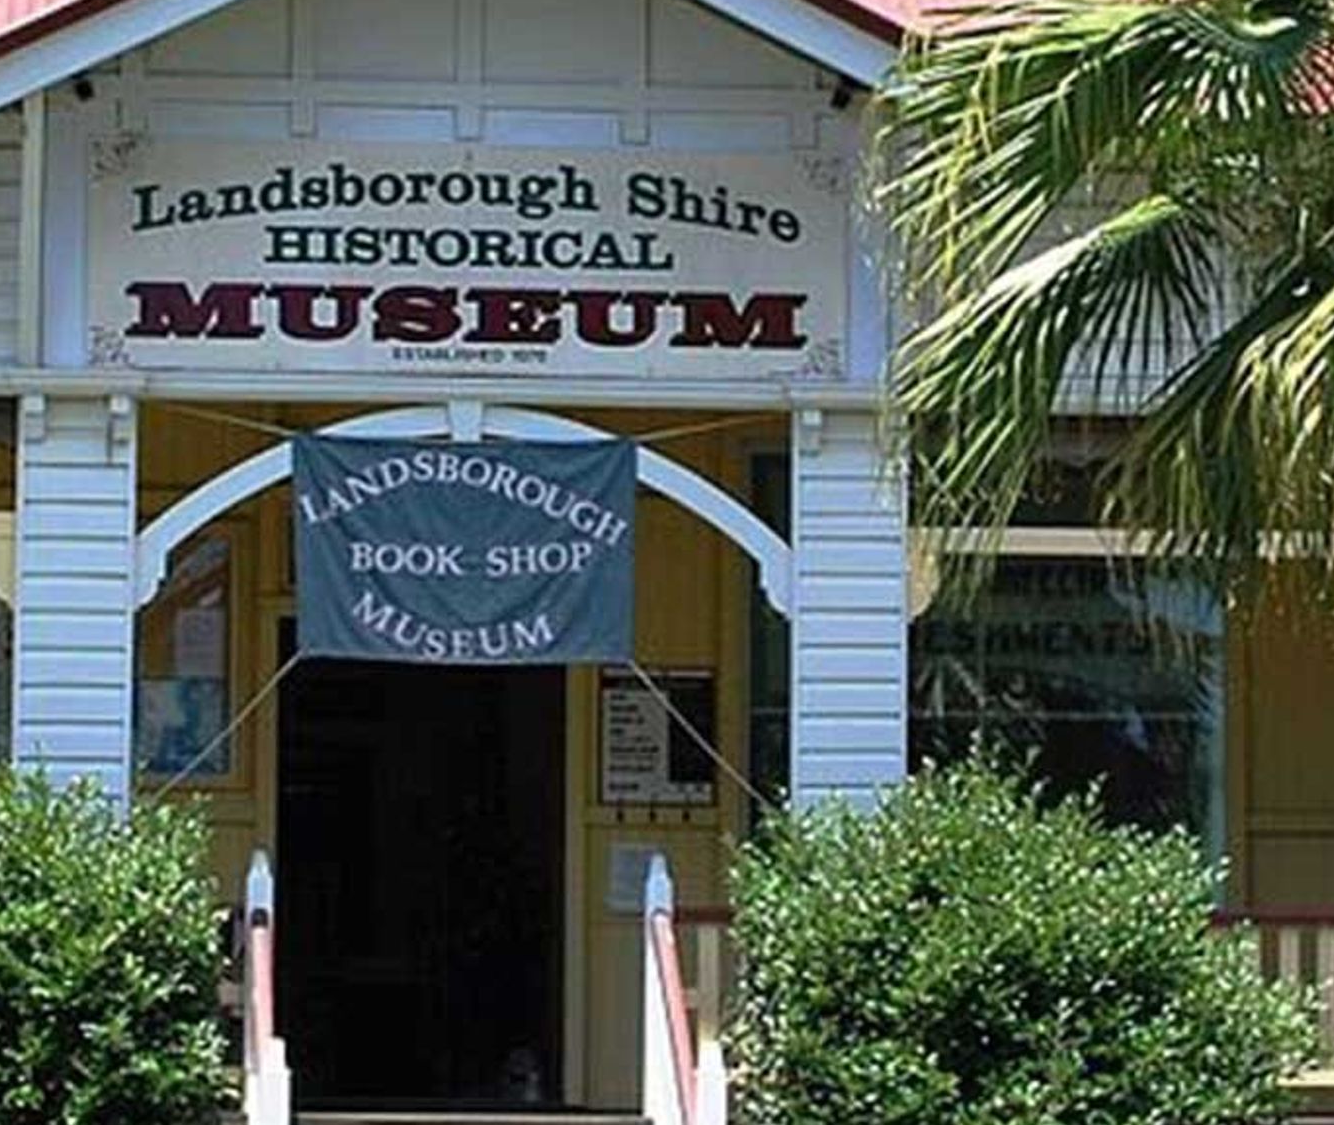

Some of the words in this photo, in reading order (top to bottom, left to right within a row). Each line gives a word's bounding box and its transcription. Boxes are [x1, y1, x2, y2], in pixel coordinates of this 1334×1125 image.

[131, 162, 600, 232] Landsborough
[628, 171, 801, 245] Shire
[265, 225, 674, 272] HISTORICAL
[124, 281, 809, 350] MUSEUM
[392, 347, 505, 363] ESTABLISHED
[299, 450, 628, 548] LANDSBOROUGH
[350, 541, 465, 576] BOOK
[486, 541, 593, 576] SHOP
[351, 591, 555, 662] MUSEUM
